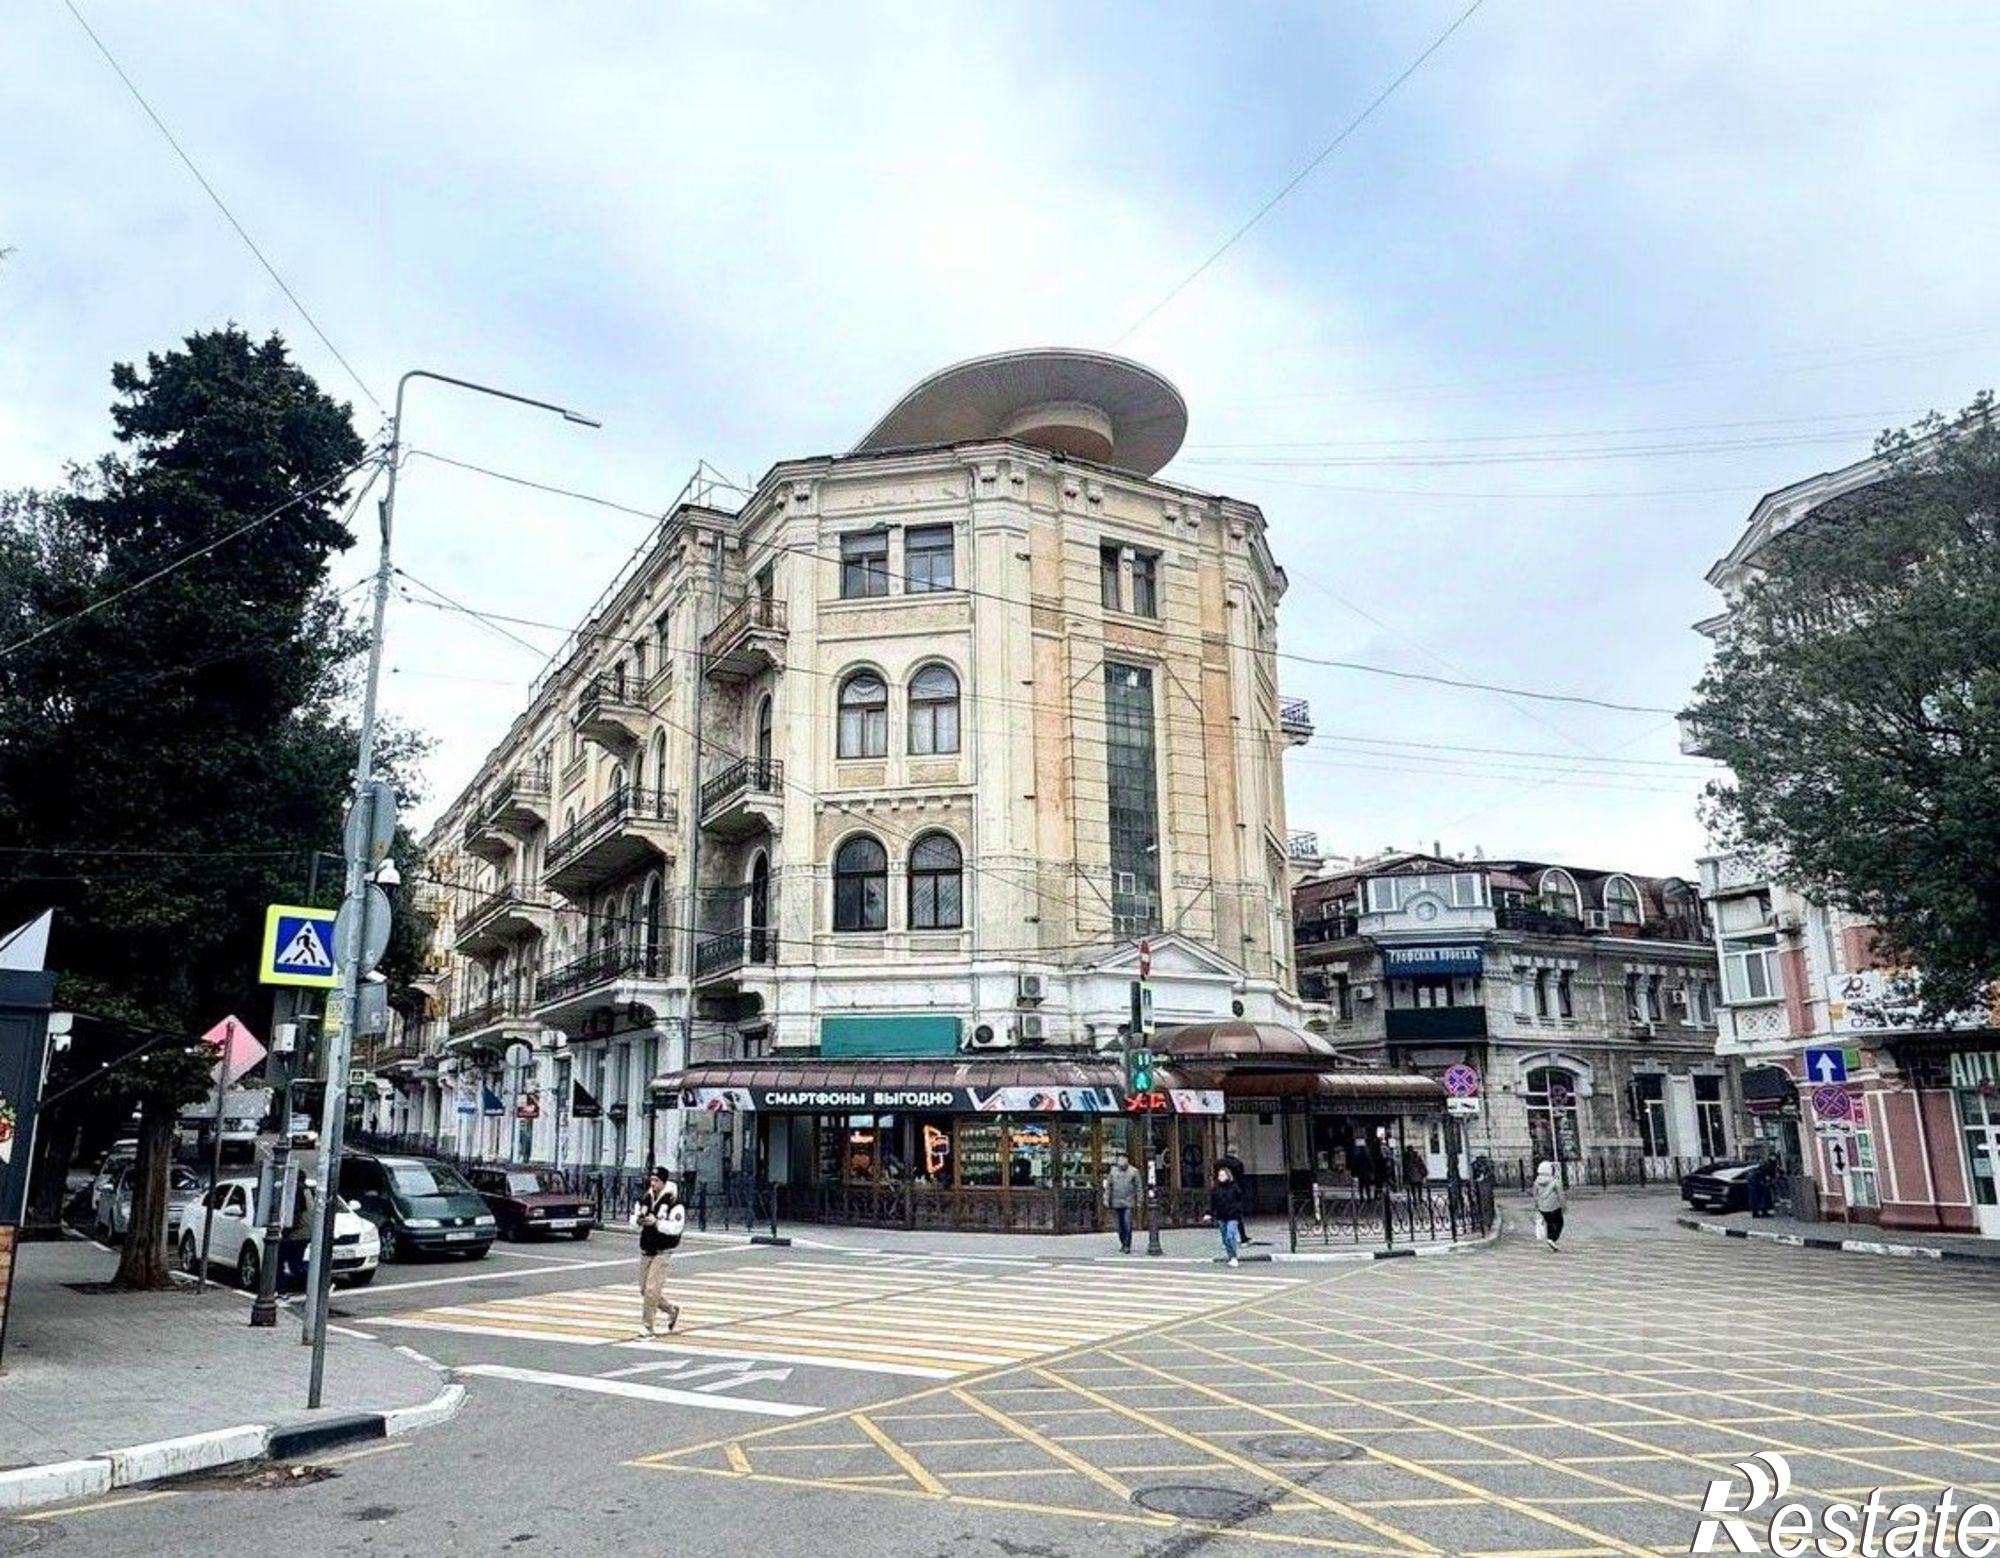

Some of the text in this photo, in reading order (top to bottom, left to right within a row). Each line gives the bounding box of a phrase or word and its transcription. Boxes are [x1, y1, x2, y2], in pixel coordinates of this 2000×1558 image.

[1950, 1051, 2000, 1087] АПТ
[765, 1092, 954, 1106] СМАРТФОНЫ ВЫГОДНО
